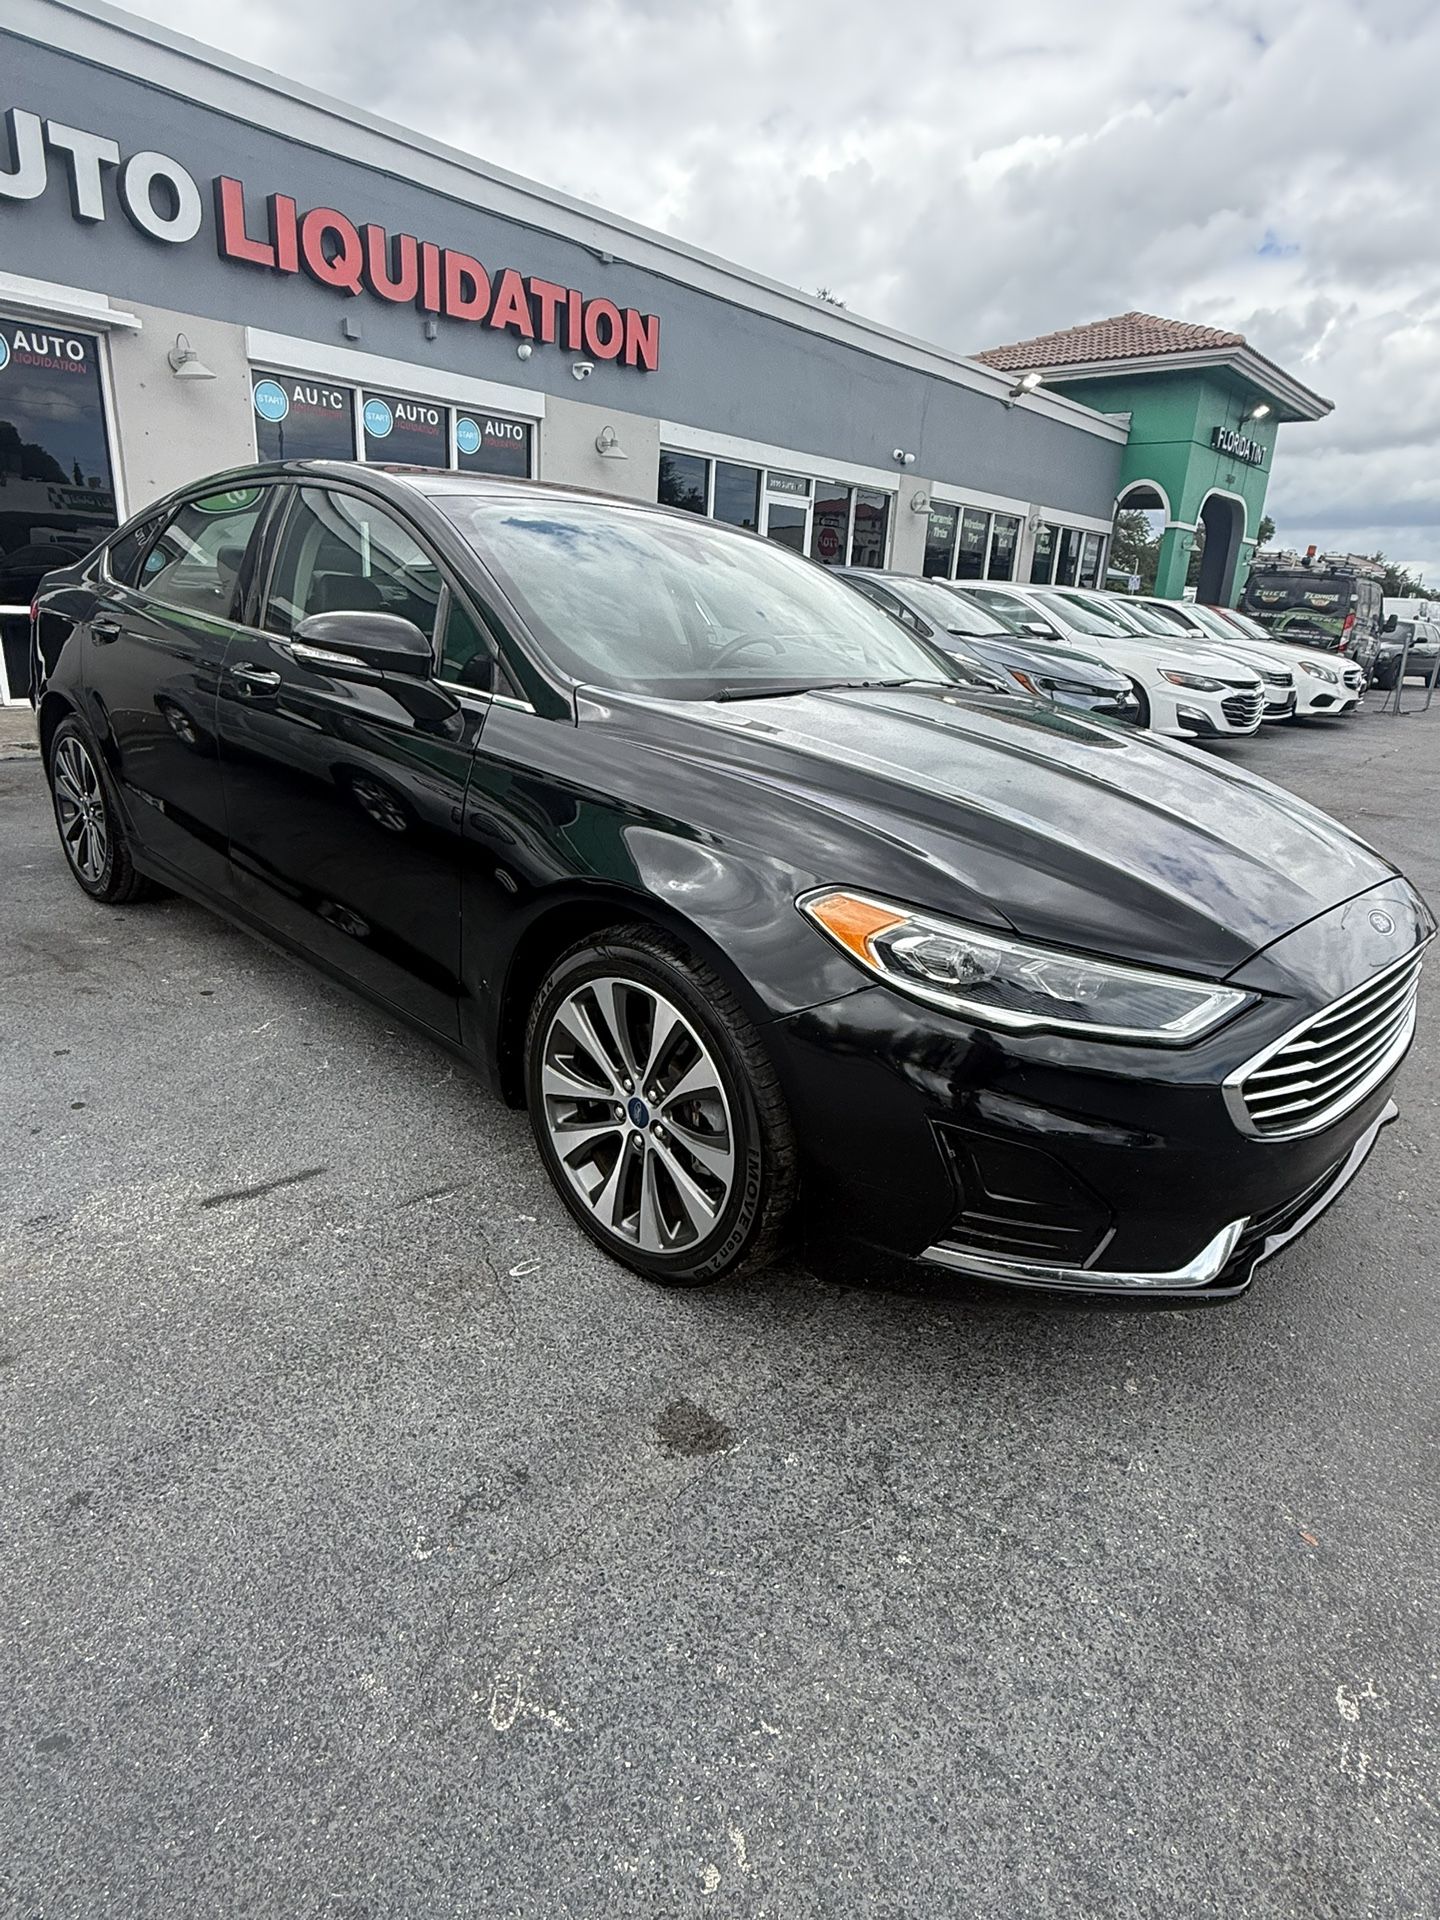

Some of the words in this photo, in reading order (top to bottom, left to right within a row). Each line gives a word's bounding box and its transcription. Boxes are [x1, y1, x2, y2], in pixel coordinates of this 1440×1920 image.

[214, 175, 660, 372] LIQUIDATION
[13, 330, 84, 361] AUTO
[12, 351, 87, 374] LIQUIDATION
[258, 394, 283, 406] START
[366, 412, 389, 422] START
[395, 403, 438, 425] AUTO
[485, 420, 523, 440] AUTO
